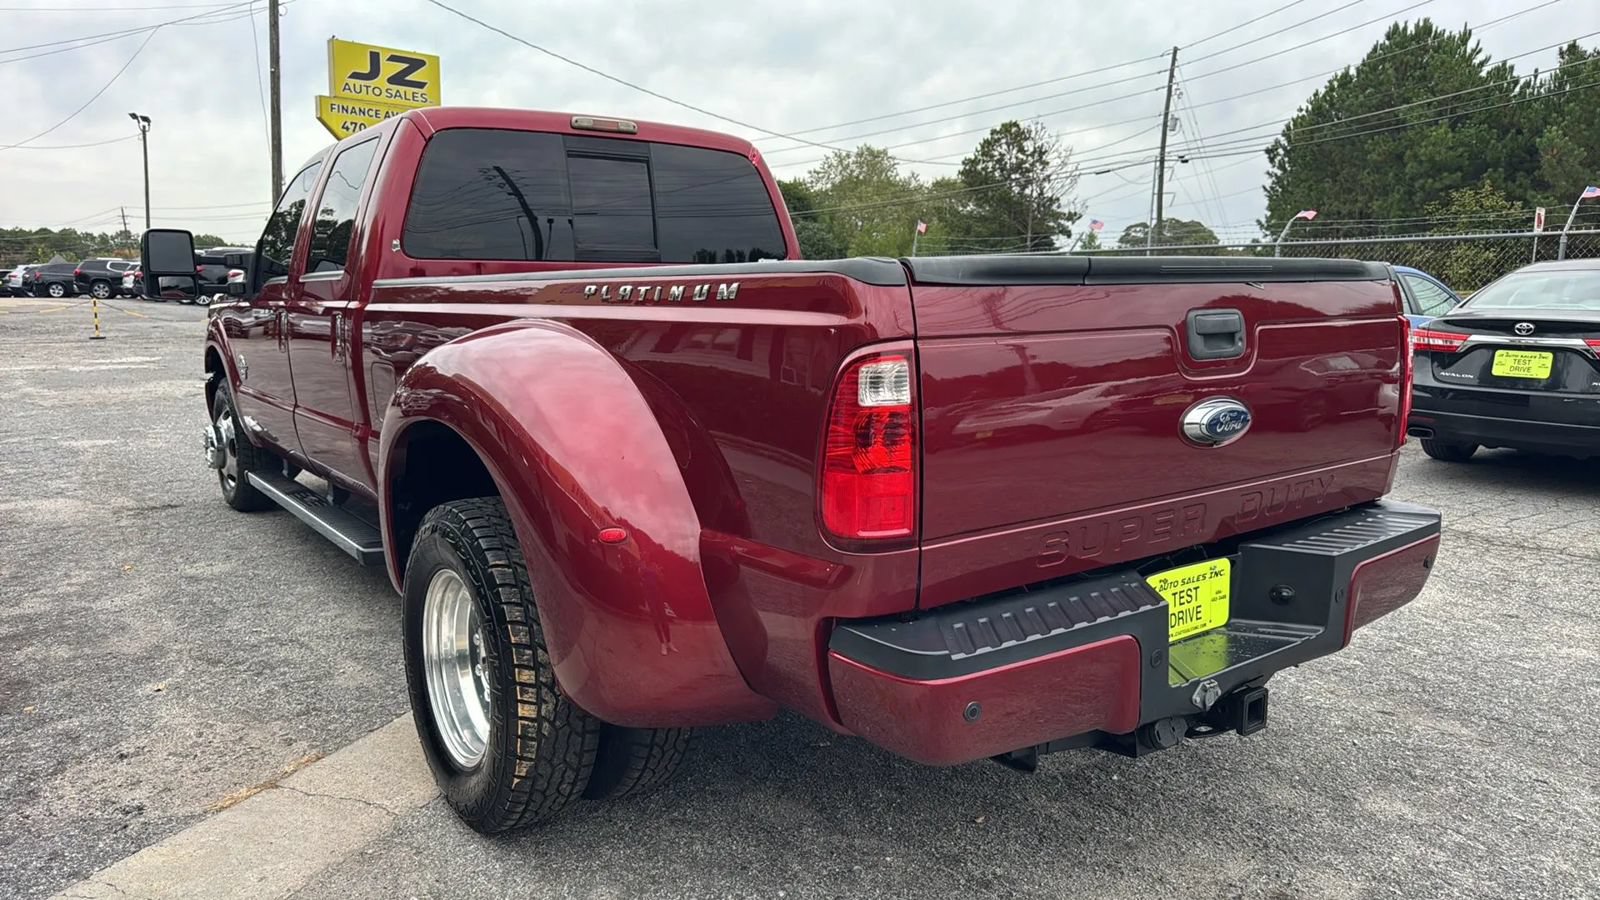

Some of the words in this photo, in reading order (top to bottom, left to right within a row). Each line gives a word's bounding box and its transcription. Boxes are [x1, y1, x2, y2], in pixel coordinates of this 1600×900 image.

[347, 50, 428, 89] JZ
[342, 82, 382, 97] AUTO
[385, 88, 428, 103] SALES
[330, 103, 381, 119] FINANCE
[584, 282, 740, 301] PLATINUM
[1509, 365, 1532, 373] DRIVE
[1216, 412, 1246, 432] Ford
[1036, 502, 1207, 568] SUPER
[1234, 474, 1336, 525] DUTY
[1159, 580, 1179, 592] AUTO
[1181, 573, 1207, 586] SALES
[1172, 586, 1200, 608] TEST
[1170, 605, 1202, 629] DRIVE
